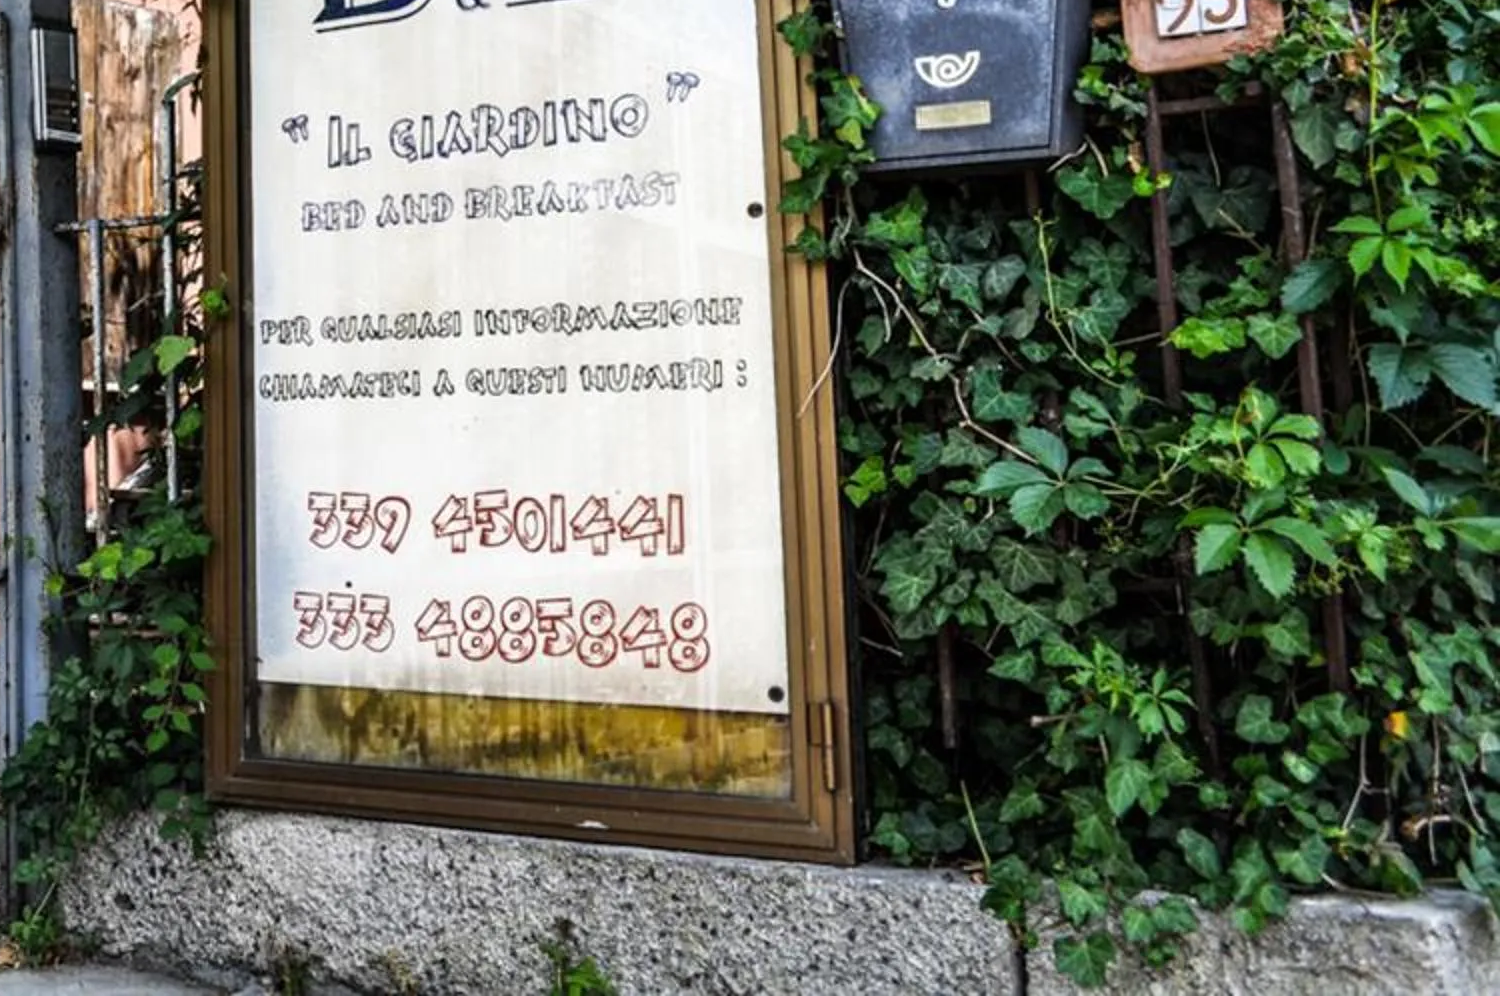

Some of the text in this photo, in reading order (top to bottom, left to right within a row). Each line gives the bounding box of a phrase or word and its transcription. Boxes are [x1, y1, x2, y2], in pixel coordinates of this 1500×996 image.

[389, 92, 649, 162] GIARDINO
[301, 171, 681, 232] BED AND BREAKFAST
[260, 297, 742, 346] PER QUALSIASI INFORMAZIONE
[259, 370, 421, 402] CHIAMATECI
[432, 368, 455, 397] A
[465, 365, 567, 397] QUESTI
[579, 357, 722, 393] NUMERI
[308, 489, 684, 557] 339 4501441
[294, 591, 710, 673] 333 4885848
